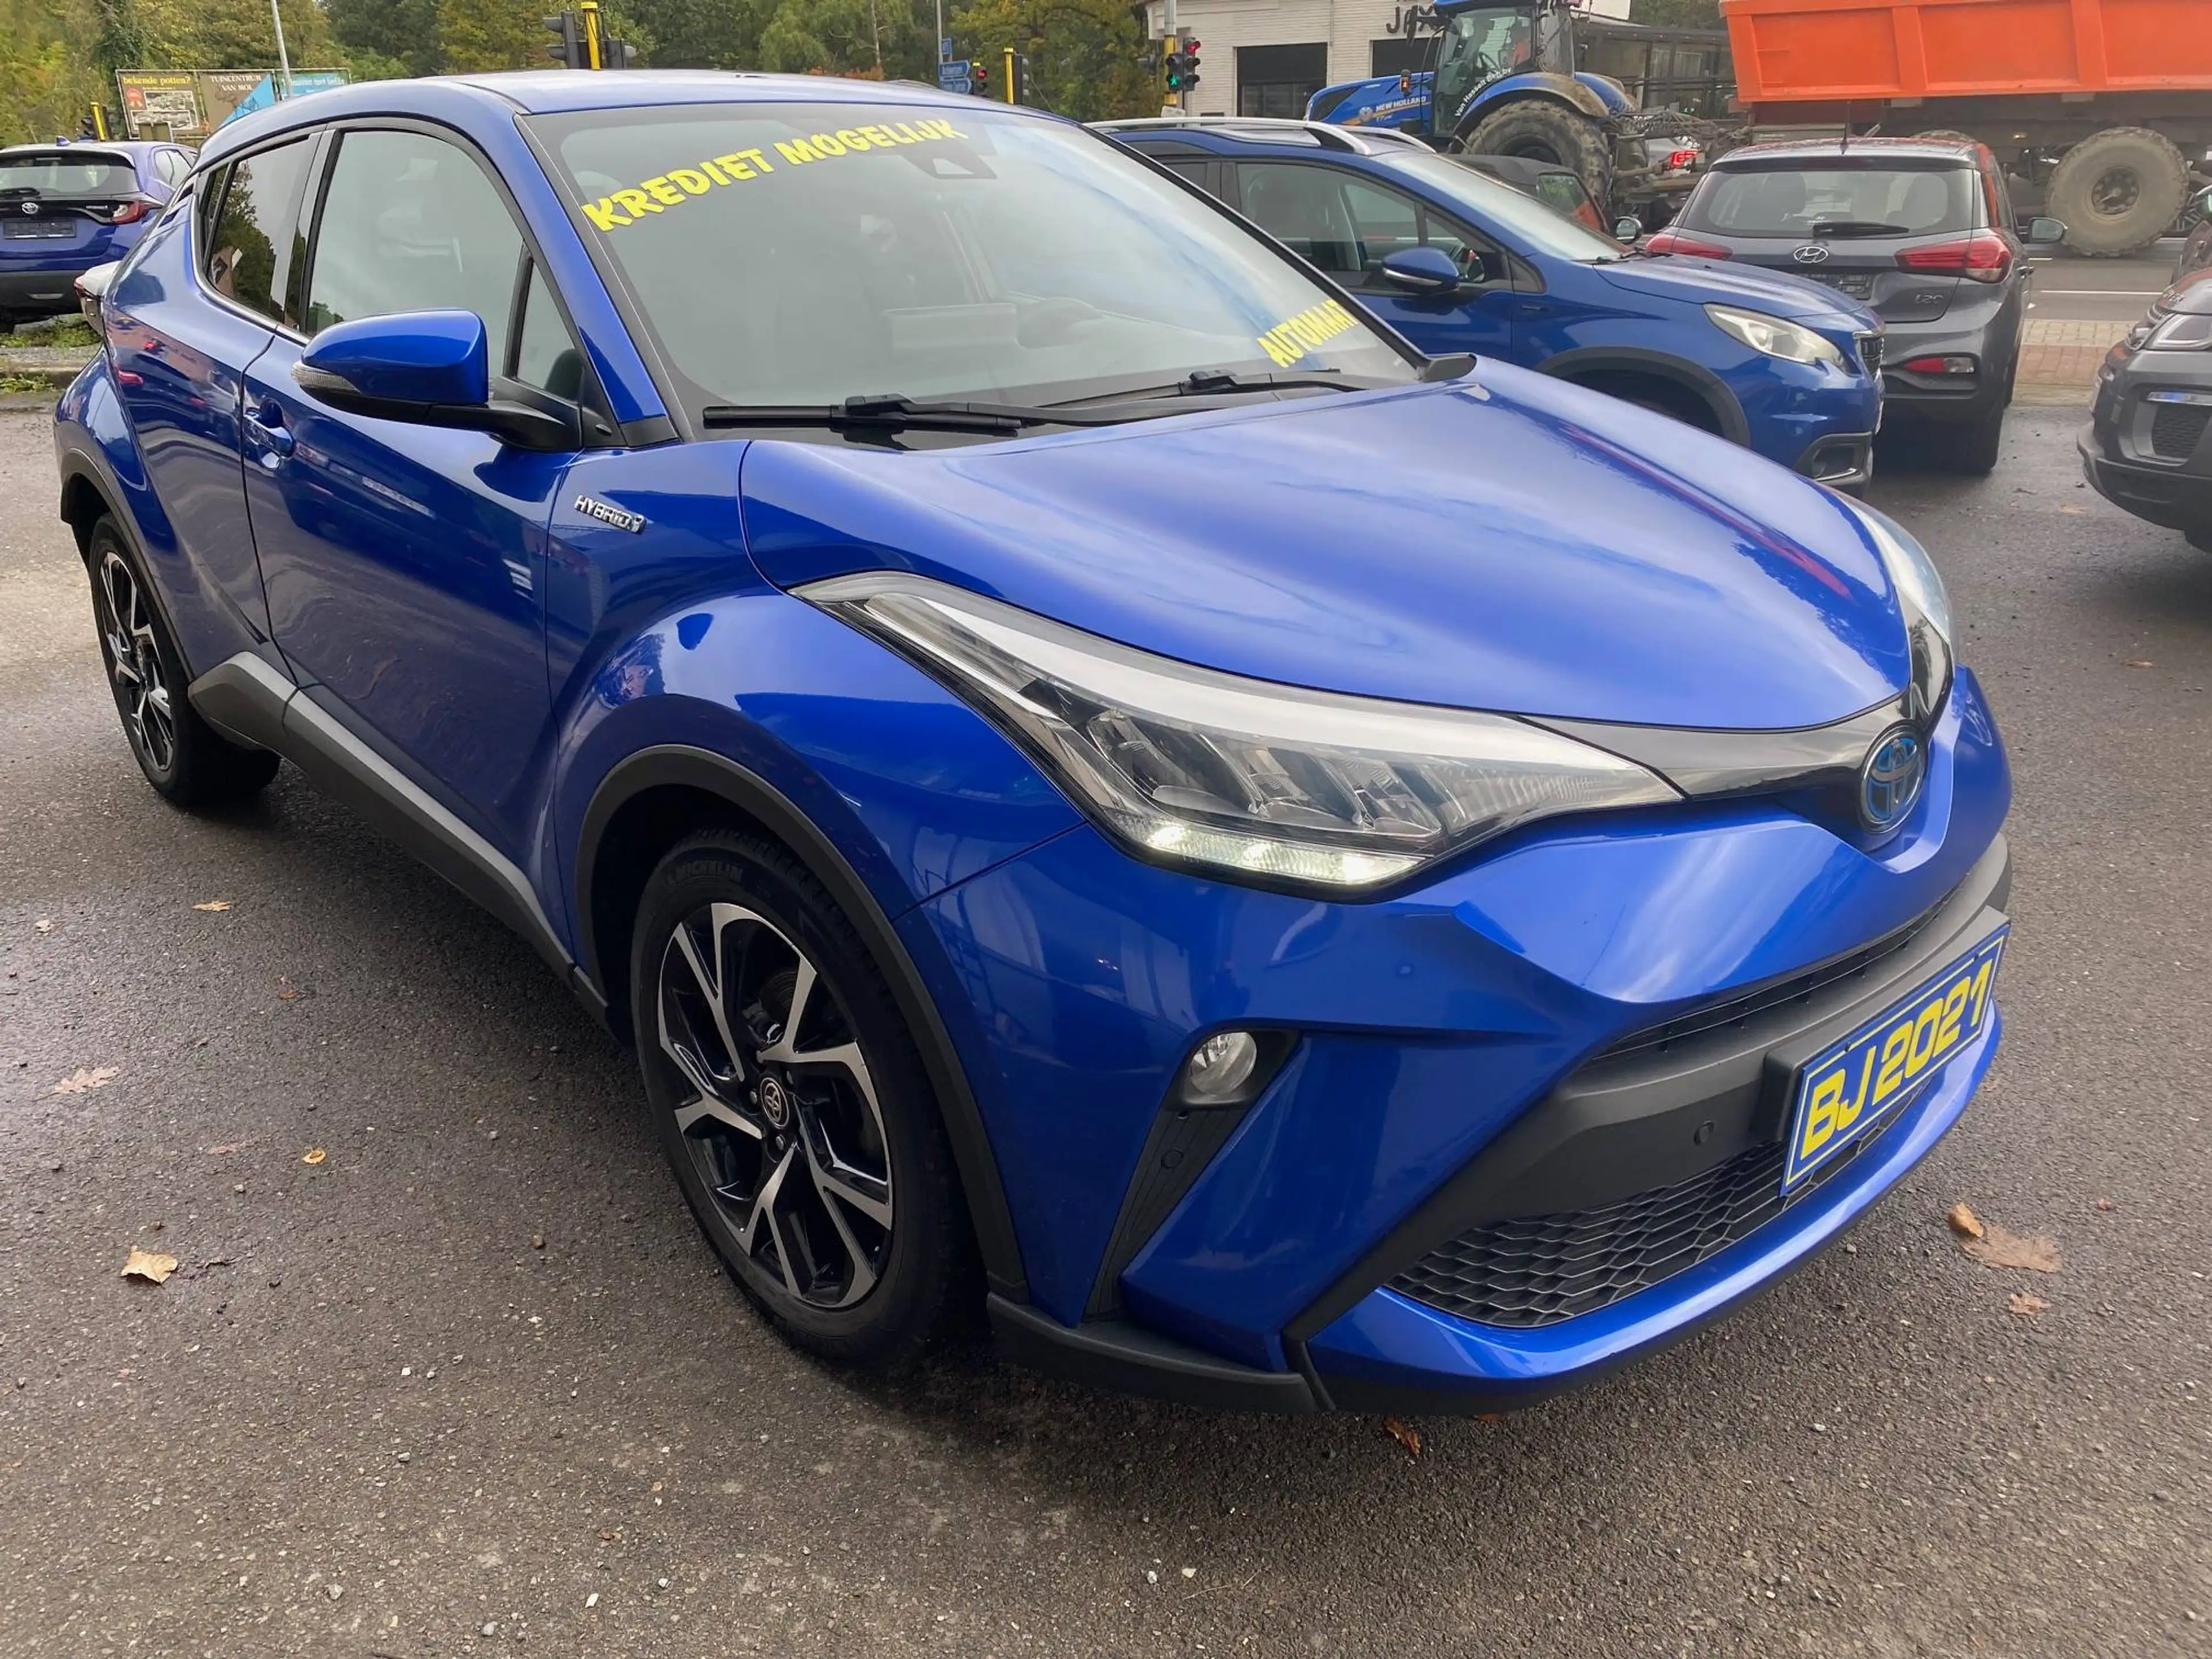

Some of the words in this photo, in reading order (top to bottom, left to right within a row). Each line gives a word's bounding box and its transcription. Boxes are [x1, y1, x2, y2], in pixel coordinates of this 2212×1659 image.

[123, 75, 157, 85] bekende
[160, 76, 191, 87] potten?
[210, 74, 262, 82] TUINCENTRUM
[1376, 101, 1393, 112] NEW
[1393, 96, 1426, 108] HOLLAND
[1455, 103, 1466, 116] Van
[581, 148, 774, 232] KREDIET
[773, 119, 969, 165] MOGELIJK
[1256, 298, 1359, 369] AUTOMAAT
[574, 494, 633, 528] HYBRID
[675, 859, 743, 884] MICHELIN
